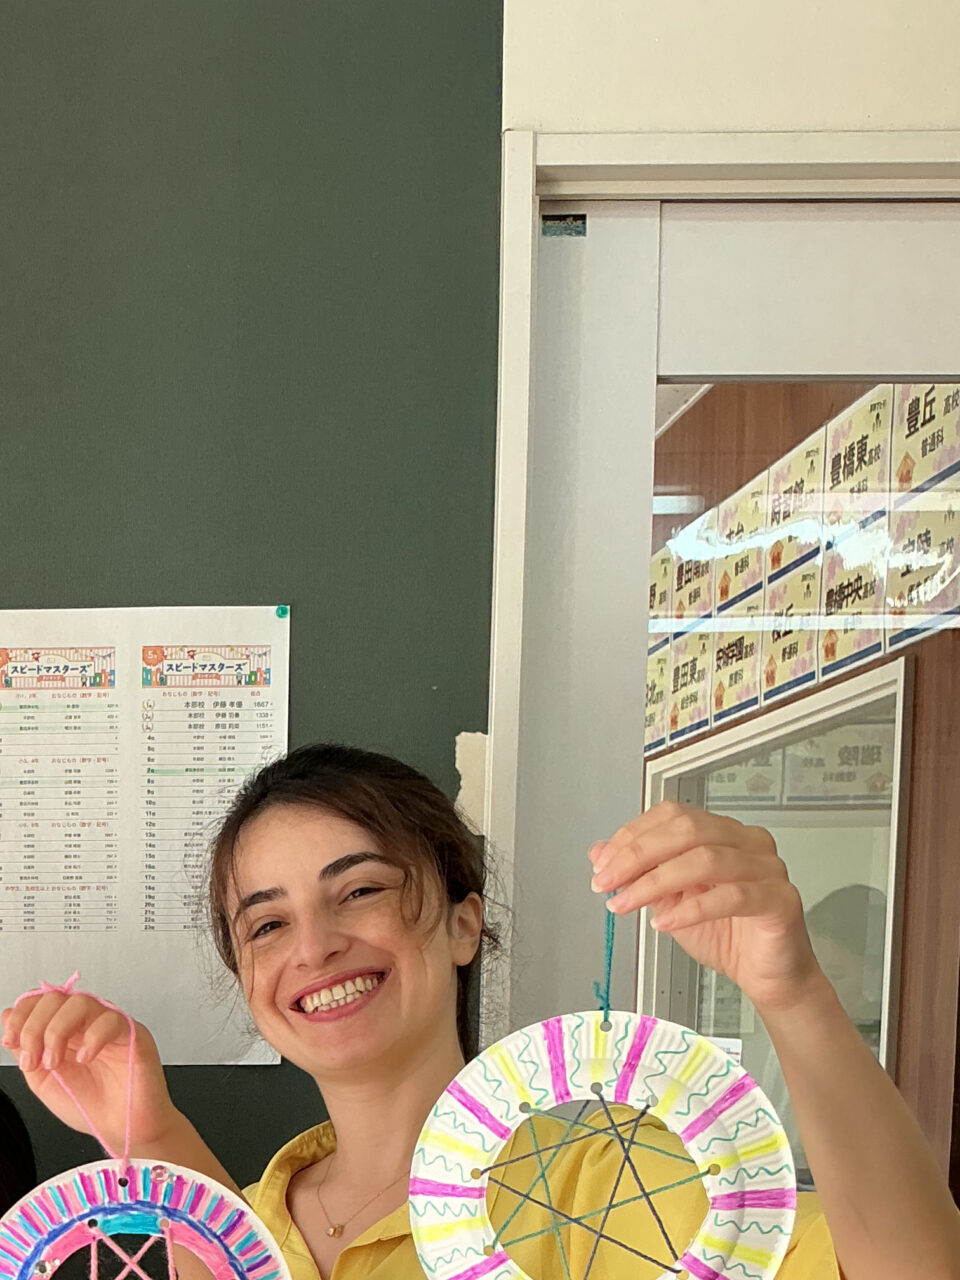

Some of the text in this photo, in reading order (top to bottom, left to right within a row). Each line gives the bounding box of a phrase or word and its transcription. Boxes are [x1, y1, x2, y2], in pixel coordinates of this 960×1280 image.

[905, 385, 936, 439] 豊丘
[11, 663, 93, 675] スピードマスターズ
[166, 662, 248, 673] スピードマスターズ
